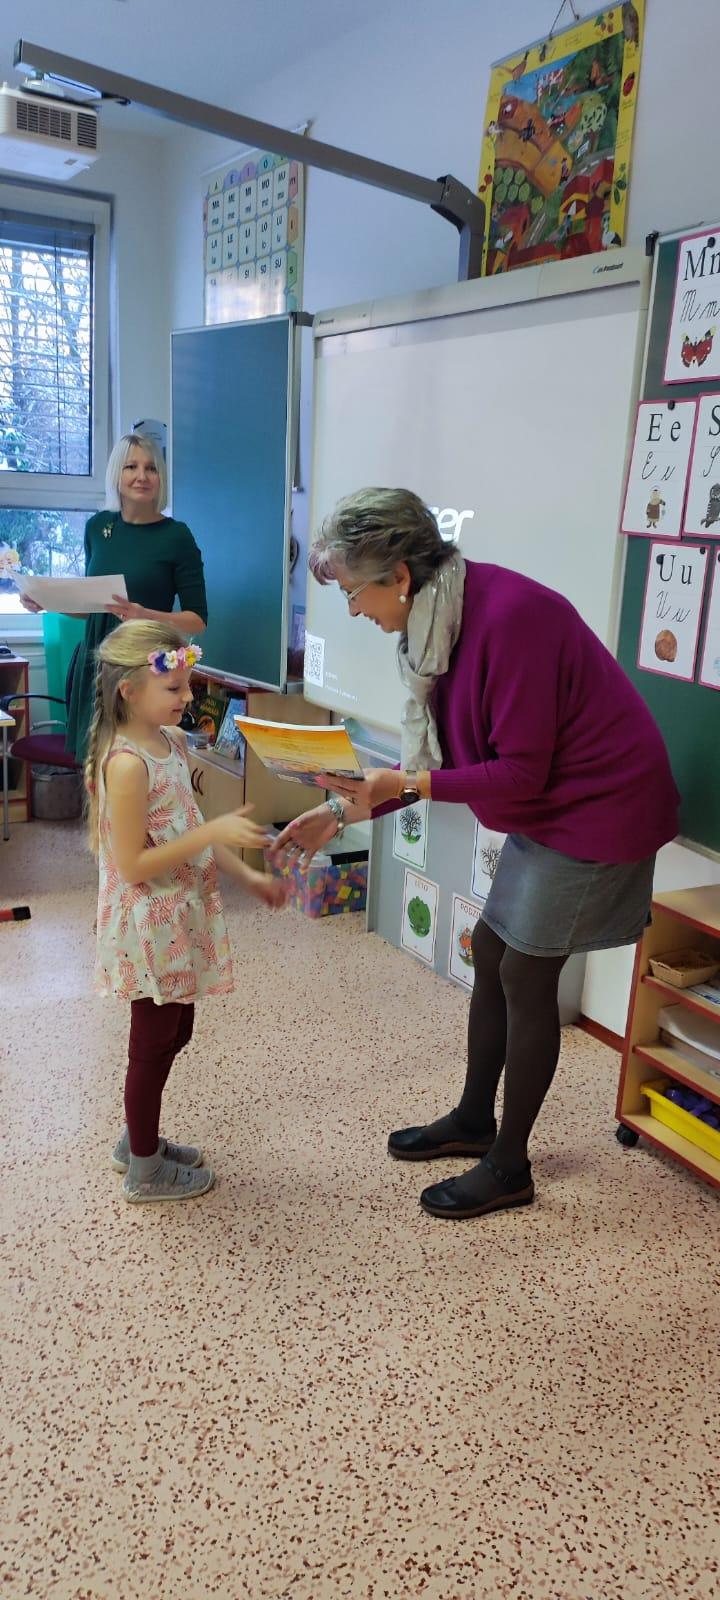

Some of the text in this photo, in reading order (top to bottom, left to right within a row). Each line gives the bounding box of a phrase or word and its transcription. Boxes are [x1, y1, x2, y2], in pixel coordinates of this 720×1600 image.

[262, 222, 268, 233] LO
[646, 413, 681, 442] E e
[428, 506, 475, 543] er
[658, 554, 692, 585] U u
